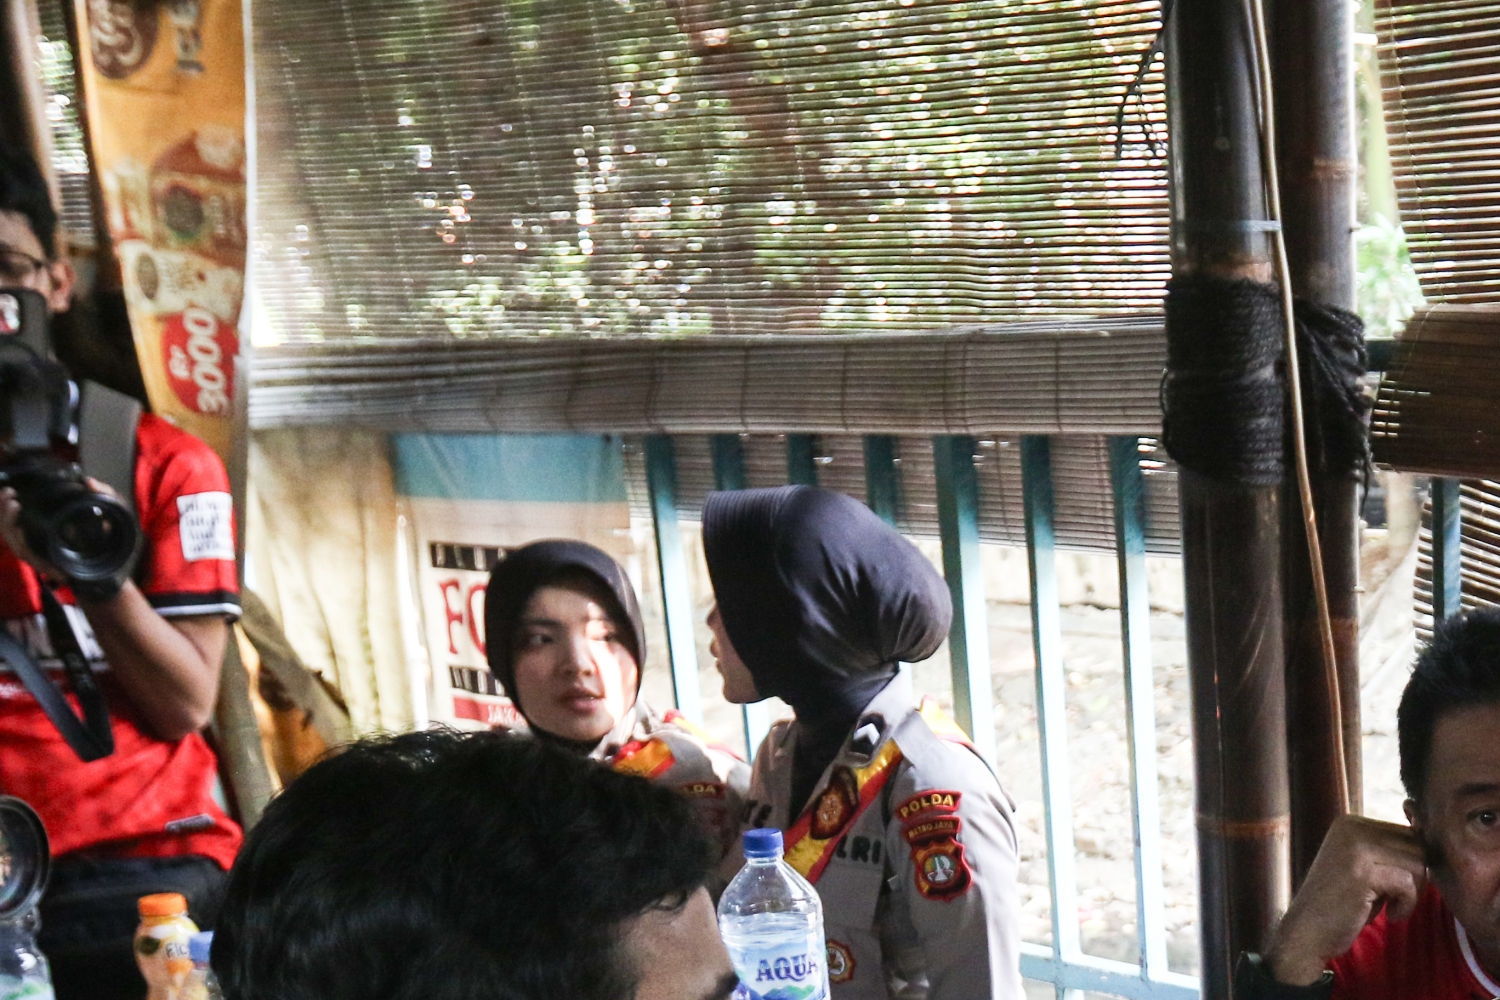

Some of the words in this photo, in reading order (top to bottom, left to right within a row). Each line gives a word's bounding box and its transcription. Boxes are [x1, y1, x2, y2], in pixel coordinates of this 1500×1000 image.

[182, 307, 228, 412] 3000
[900, 793, 955, 818] POLDA
[756, 953, 818, 981] AQUA
